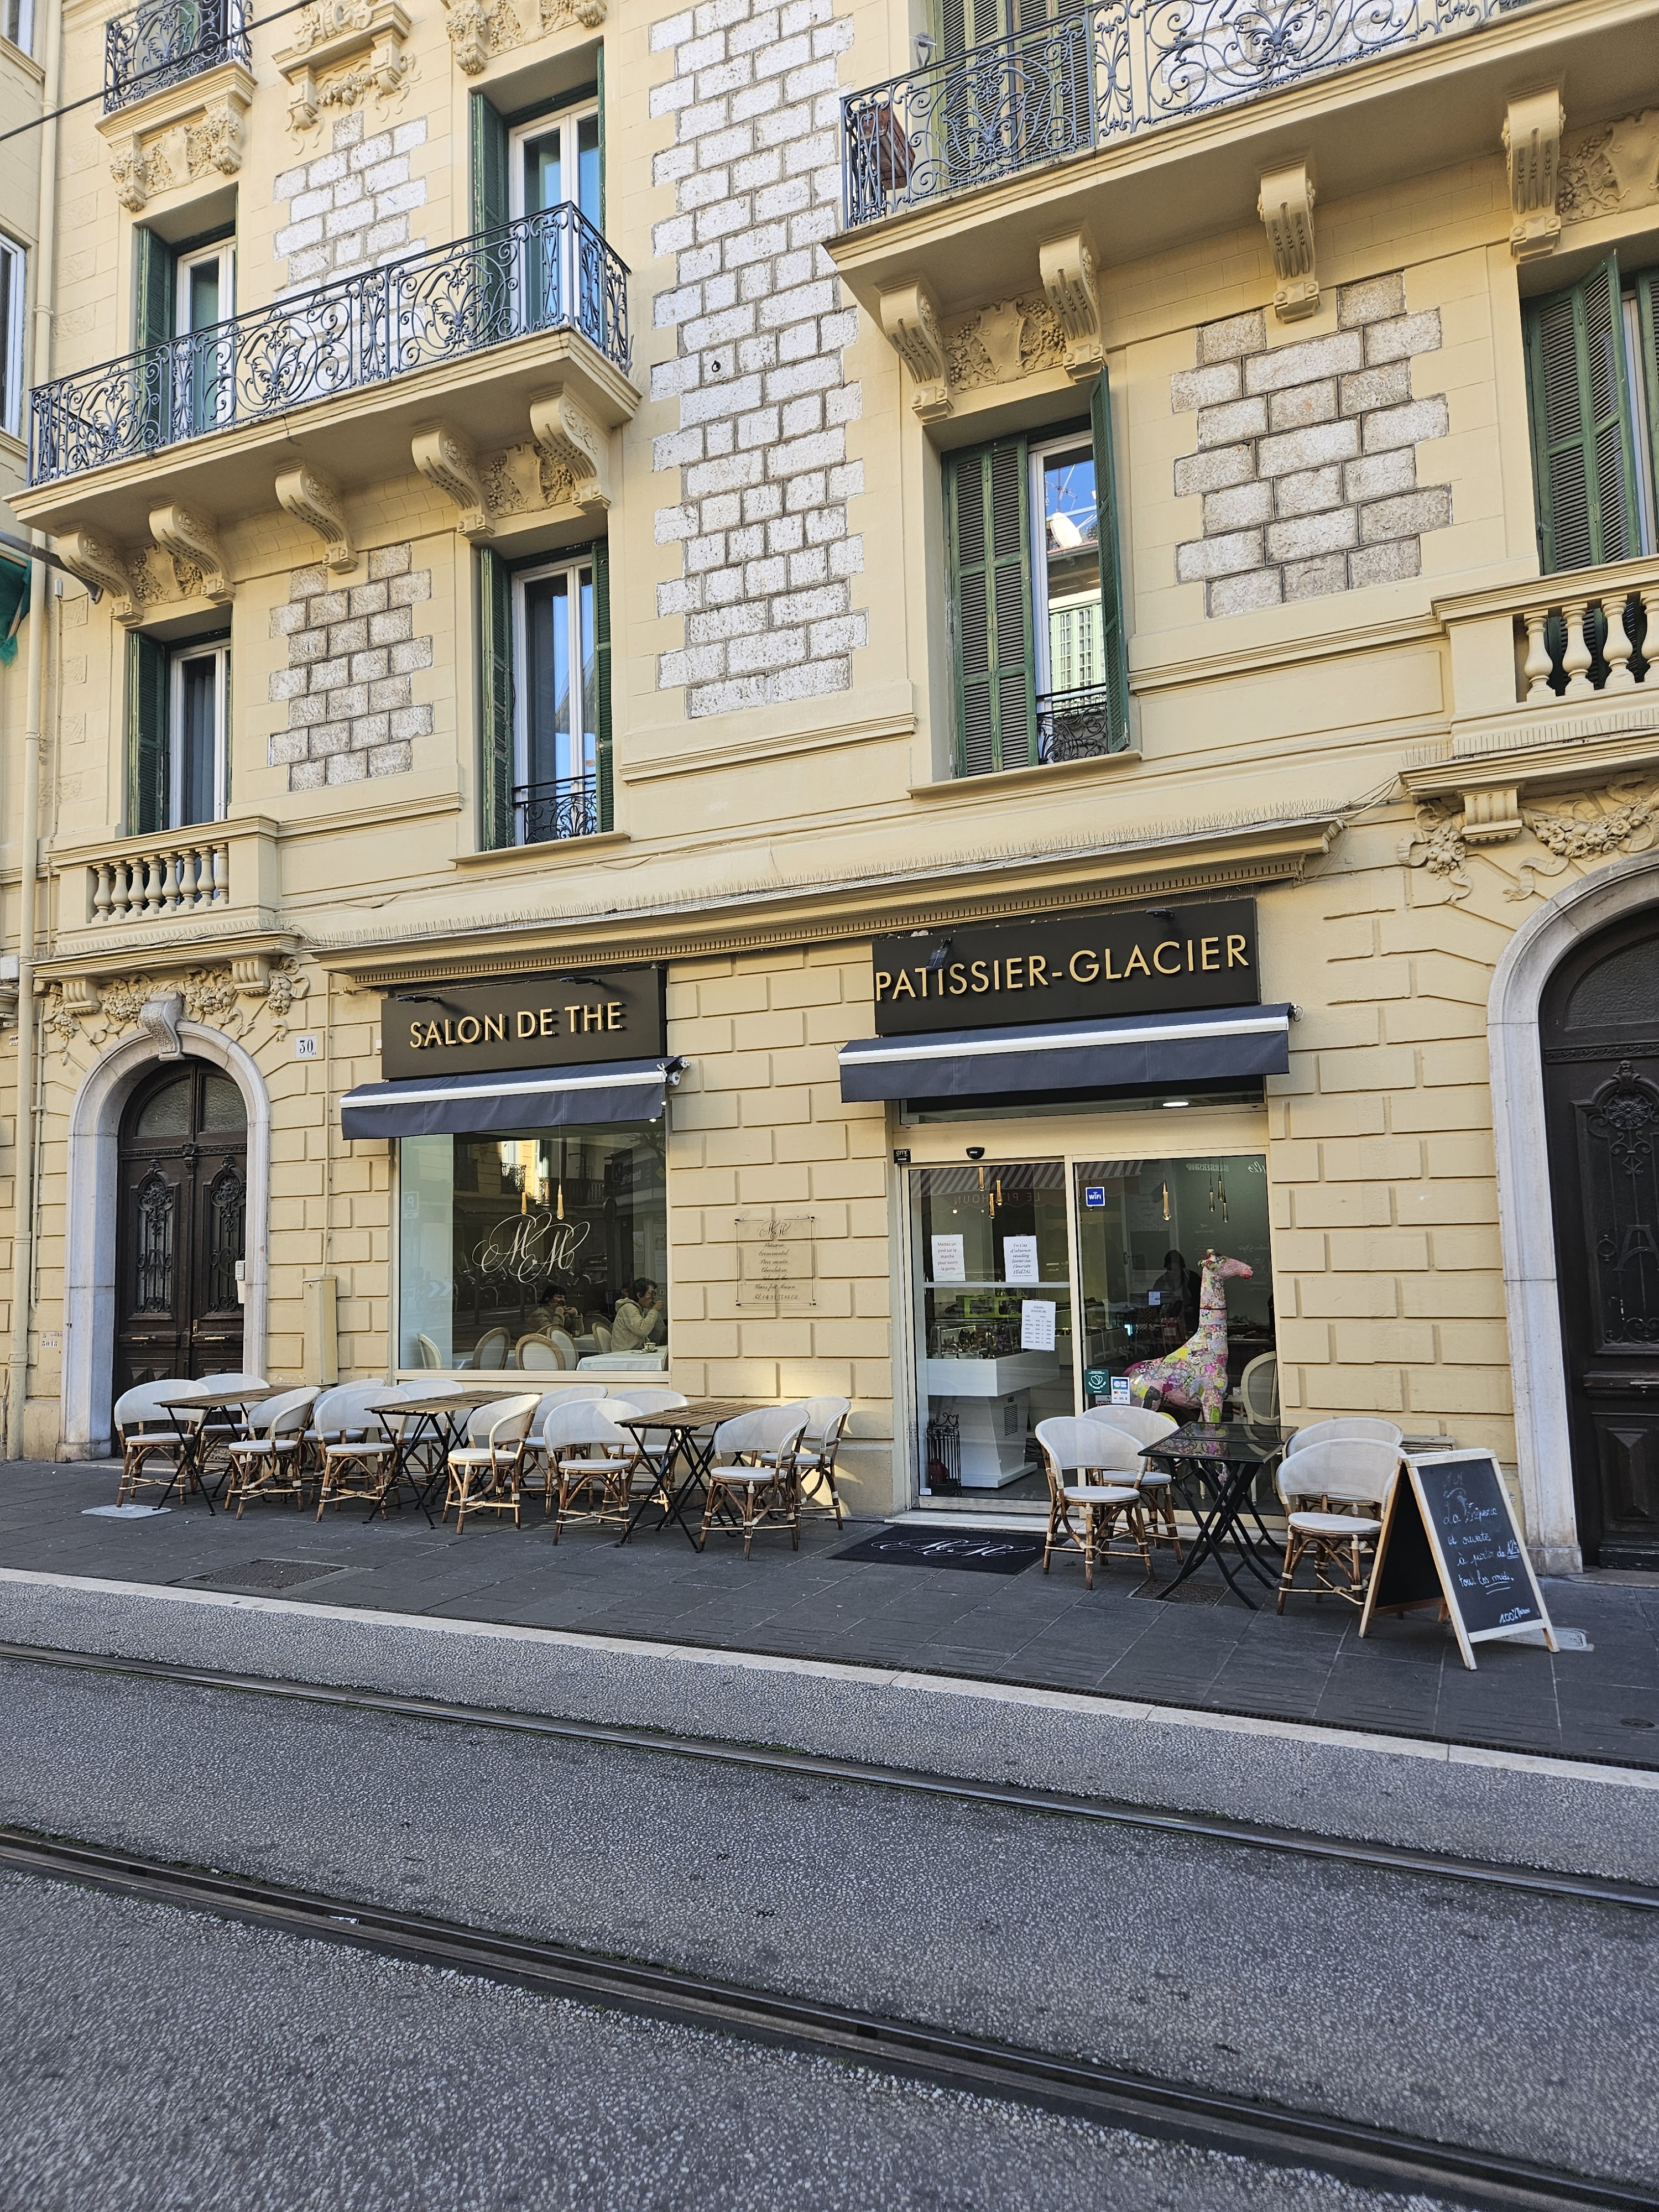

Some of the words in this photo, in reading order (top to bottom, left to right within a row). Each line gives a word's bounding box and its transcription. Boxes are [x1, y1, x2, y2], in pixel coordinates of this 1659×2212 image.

[875, 933, 1250, 1002] PATISSIER-GLACIER
[409, 1013, 504, 1049] SALON
[517, 1008, 553, 1039] DE
[564, 1001, 622, 1034] THE
[299, 1039, 314, 1054] 30
[1496, 1546, 1507, 1558] de
